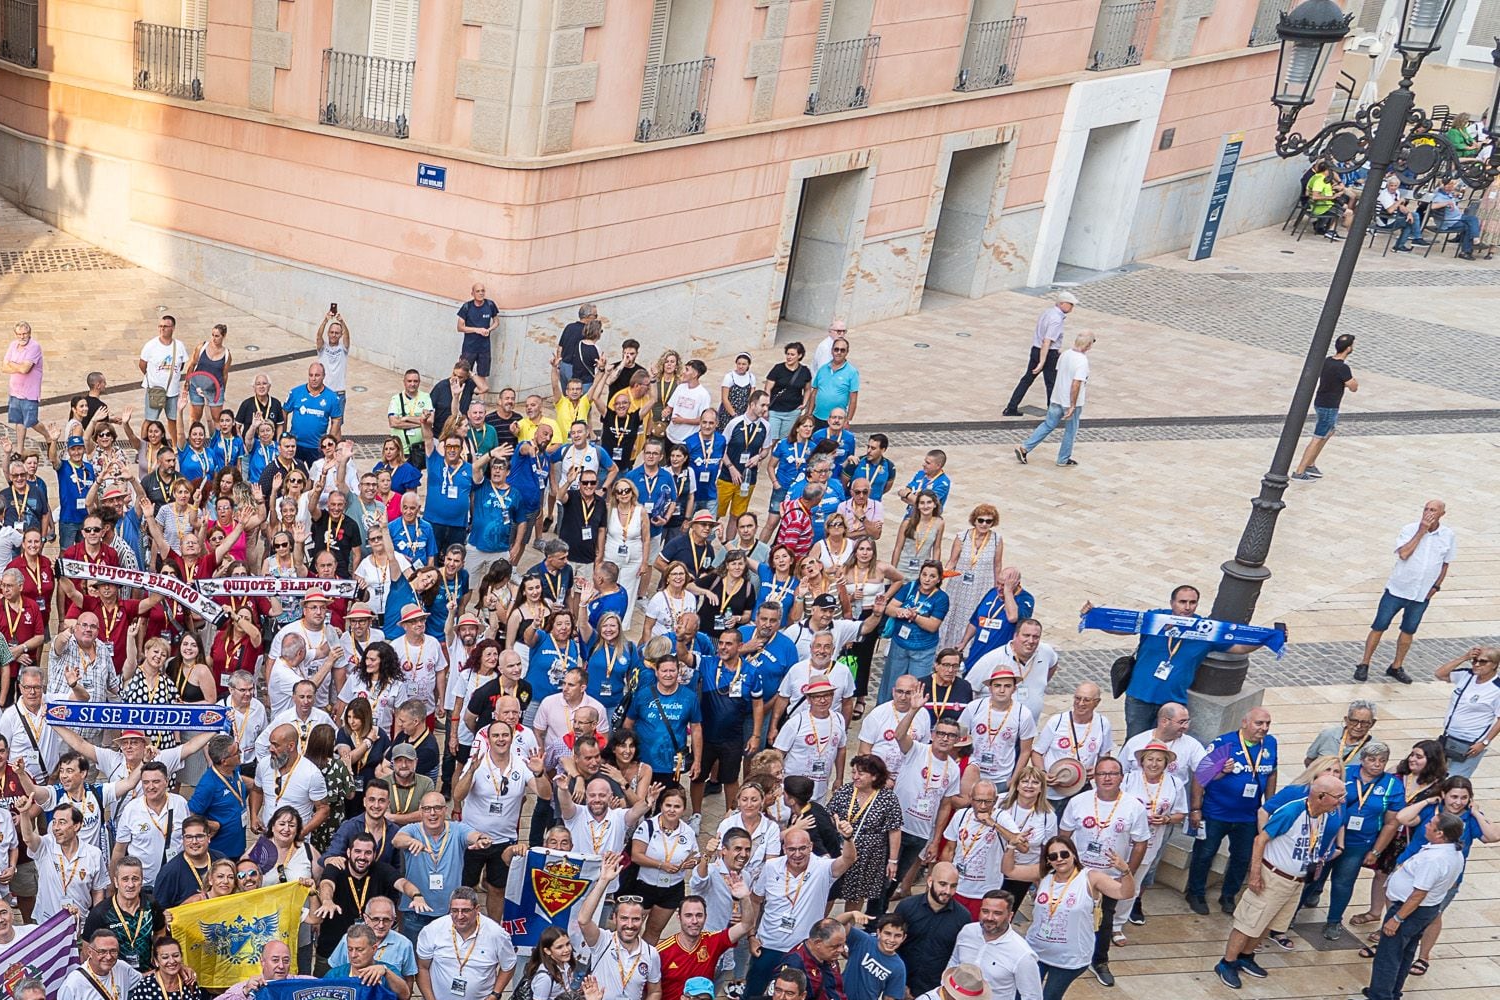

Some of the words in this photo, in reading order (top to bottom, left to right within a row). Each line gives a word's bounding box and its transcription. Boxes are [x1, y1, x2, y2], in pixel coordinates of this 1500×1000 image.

[88, 564, 144, 583] QUIJOTE
[149, 574, 198, 603] BLANCO
[223, 580, 276, 593] QUIJOTE
[281, 581, 331, 592] BLANCO
[79, 707, 96, 722] SI
[101, 708, 122, 723] SE
[128, 709, 192, 725] PUEDE
[861, 953, 892, 981] VANS
